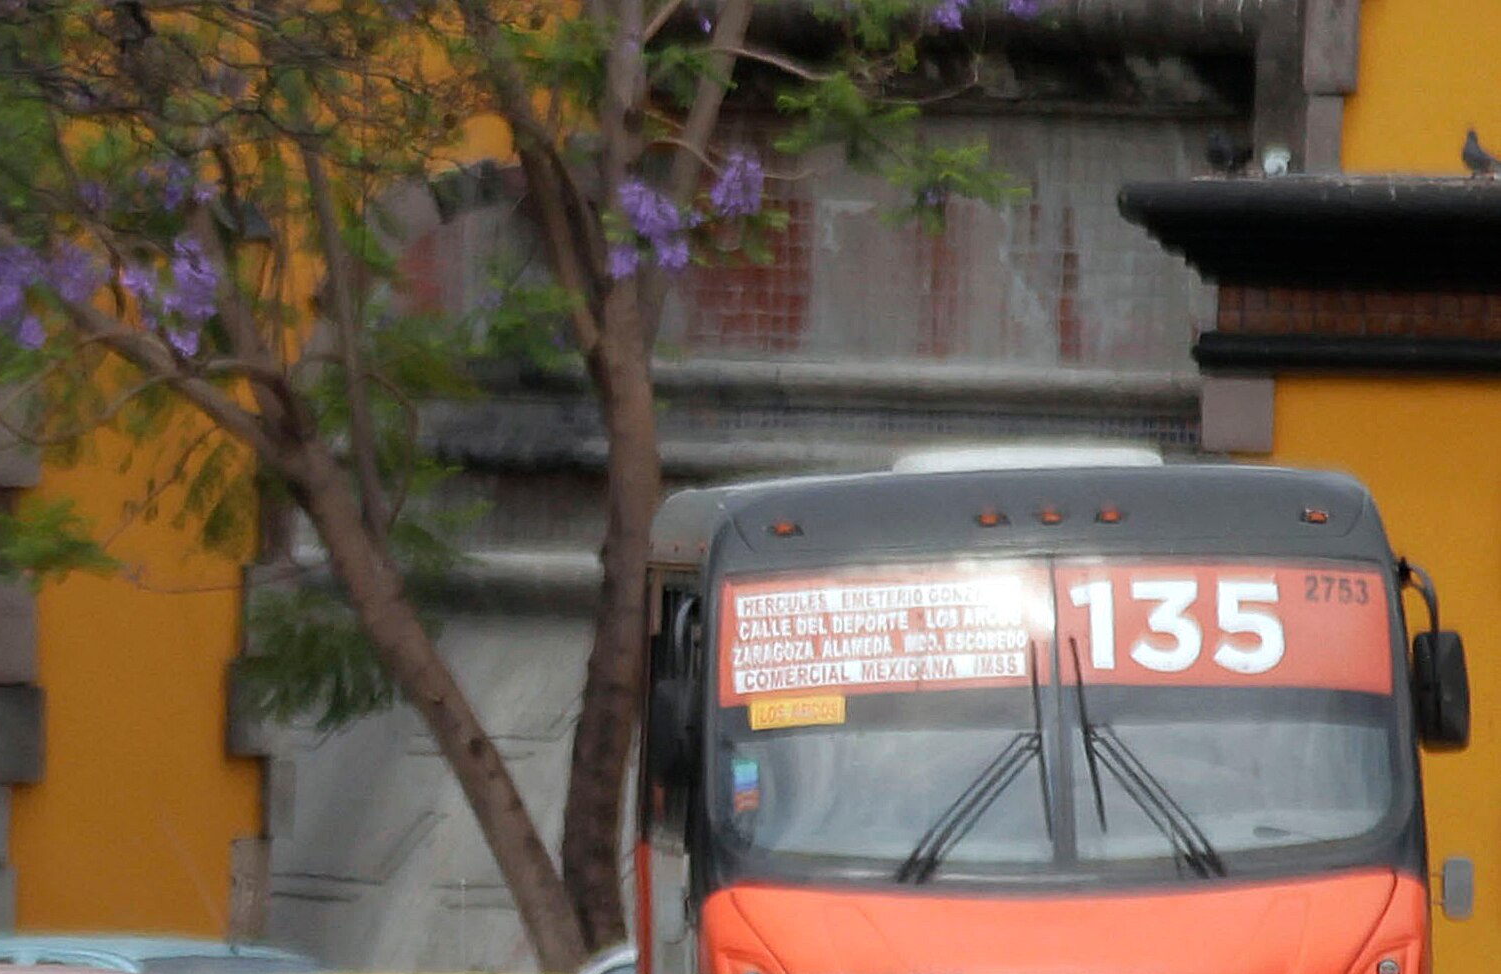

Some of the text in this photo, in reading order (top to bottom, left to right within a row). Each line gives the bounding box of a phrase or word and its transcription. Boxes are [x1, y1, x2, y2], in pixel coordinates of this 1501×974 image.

[742, 591, 828, 616] HERCULES
[1305, 575, 1369, 604] 2753
[738, 617, 792, 641] CALLE
[796, 615, 828, 636] DEL
[833, 611, 909, 634] DEPORTE
[926, 608, 959, 629] LOS
[1069, 577, 1286, 675] 135
[733, 640, 815, 667] ZARAGOZA
[822, 635, 894, 658] ALAMEDA
[945, 629, 1029, 651] ESCOBEDO
[743, 655, 1019, 689] COMERCIAL MEXICANA IMSS
